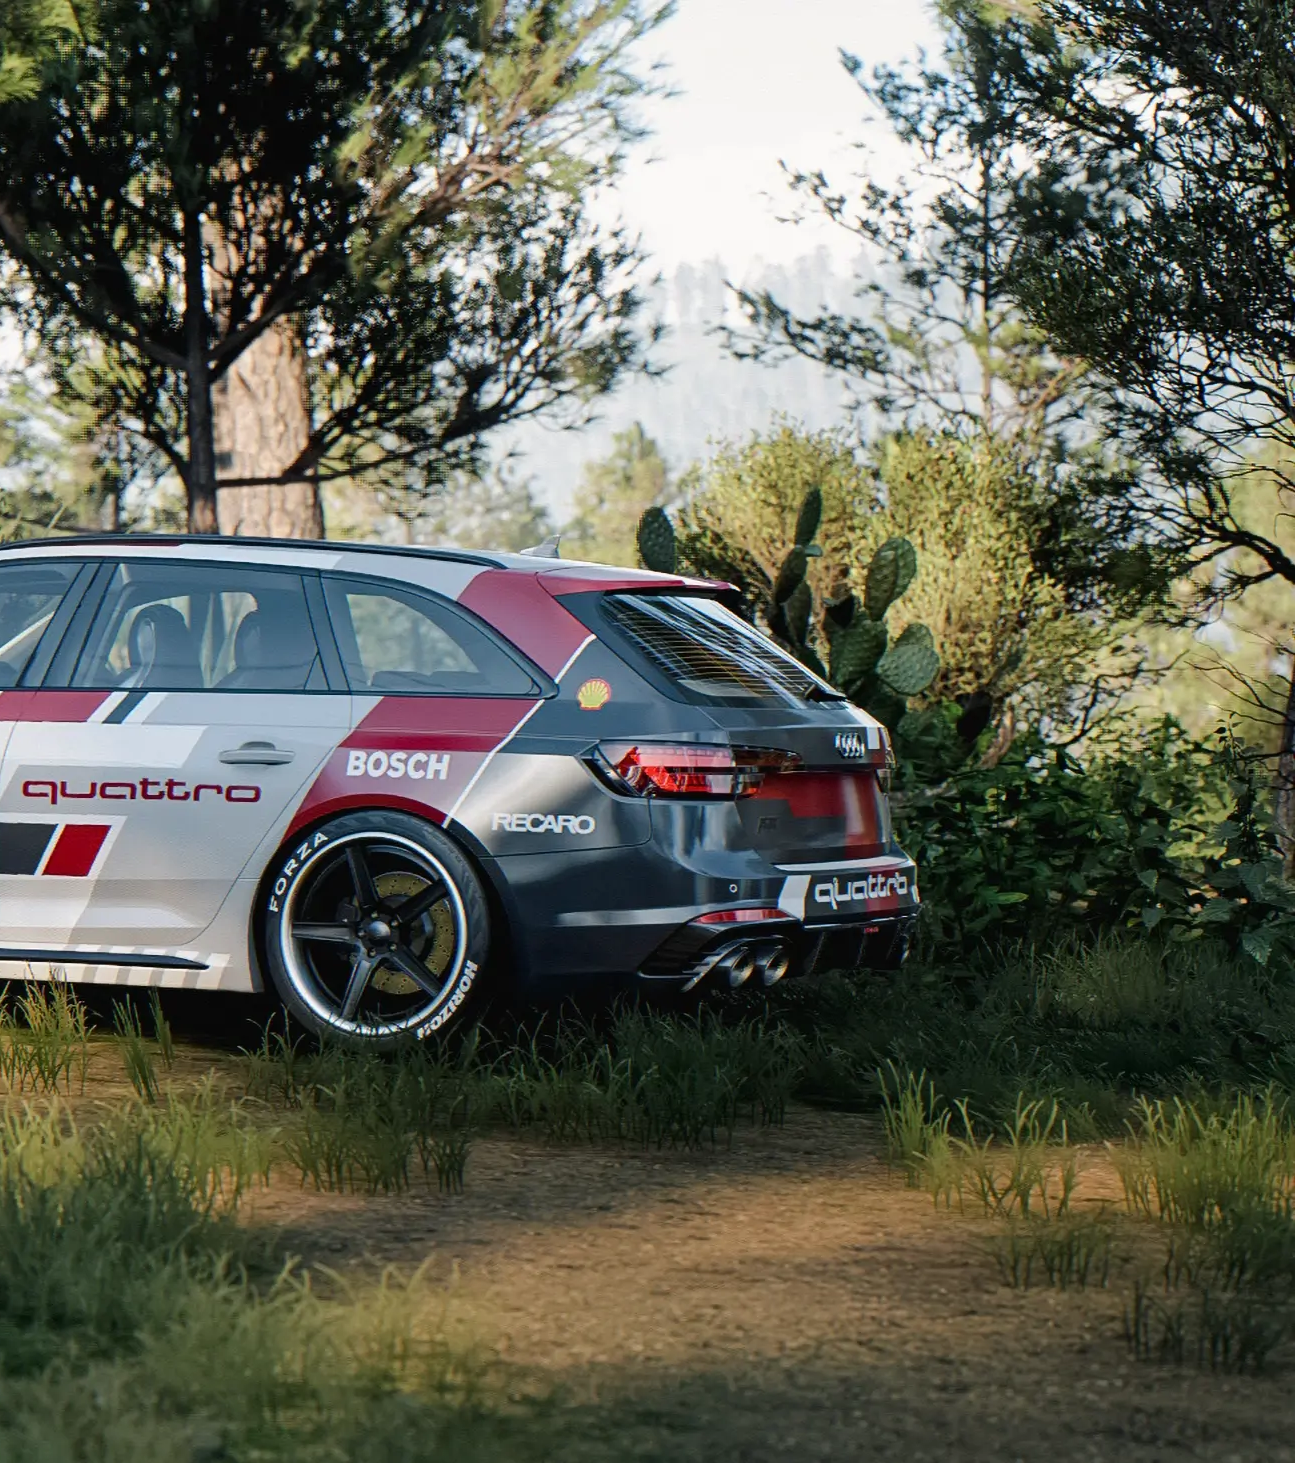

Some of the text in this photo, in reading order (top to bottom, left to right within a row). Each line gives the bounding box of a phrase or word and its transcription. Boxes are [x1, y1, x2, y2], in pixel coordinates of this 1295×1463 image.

[346, 751, 449, 779] BOSCH
[22, 778, 262, 805] quattro
[491, 812, 595, 835] RECARO
[269, 832, 329, 912] FORZA
[815, 872, 908, 910] quattro
